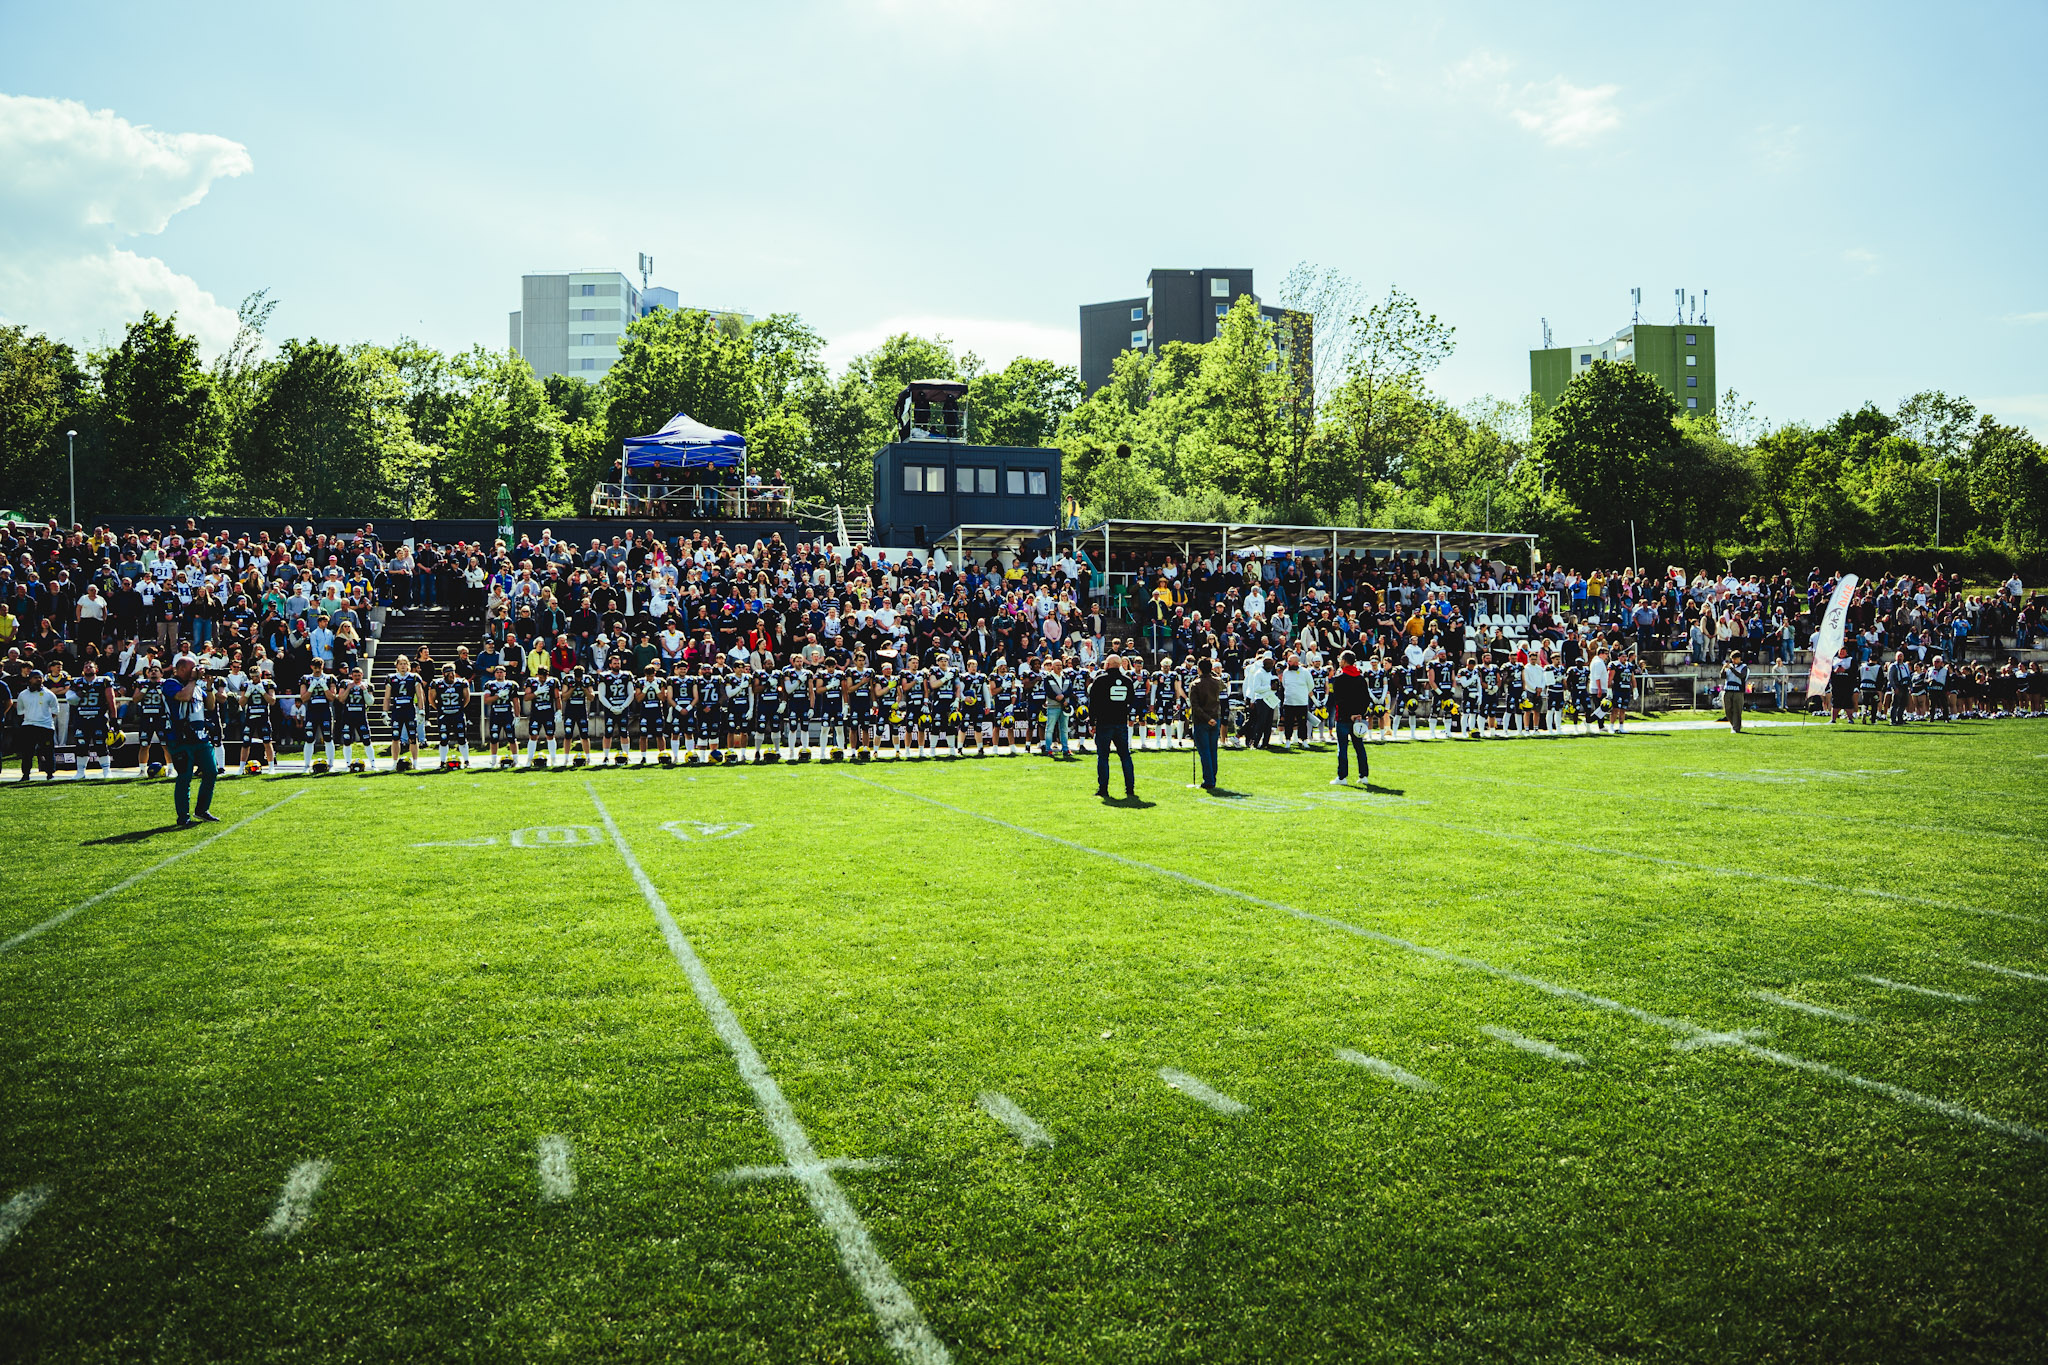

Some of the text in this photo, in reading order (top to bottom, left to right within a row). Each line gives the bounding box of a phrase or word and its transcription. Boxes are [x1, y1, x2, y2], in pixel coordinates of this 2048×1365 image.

[1440, 671, 1451, 682] 71
[1072, 679, 1087, 691] 45
[1163, 681, 1172, 691] 3
[1313, 678, 1326, 688] 33
[1374, 678, 1381, 688] 6
[398, 684, 408, 696] 4
[608, 684, 626, 697] 92
[679, 687, 688, 698] 8
[700, 688, 719, 701] 76
[440, 692, 460, 706] 52
